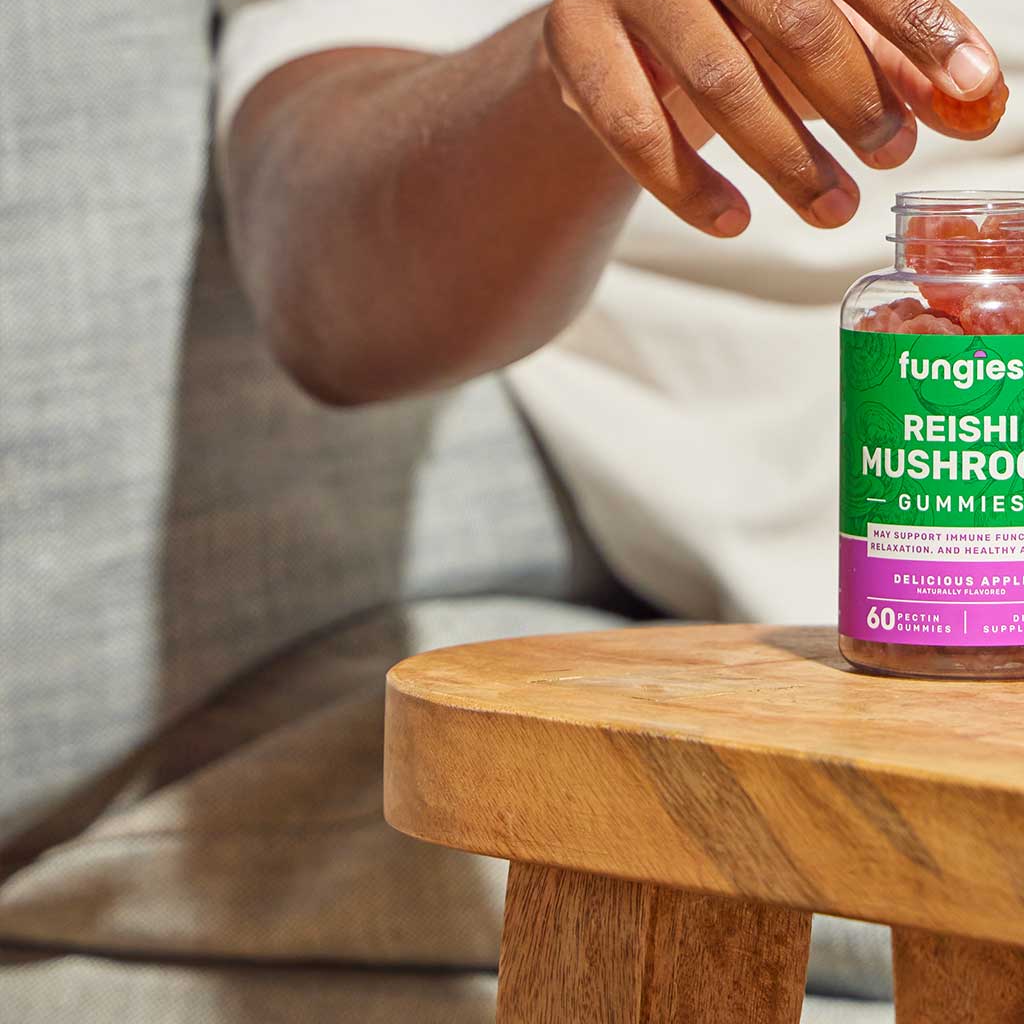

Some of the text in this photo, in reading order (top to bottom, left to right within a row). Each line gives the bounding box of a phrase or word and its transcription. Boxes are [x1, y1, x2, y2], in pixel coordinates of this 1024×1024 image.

[904, 415, 1018, 442] REISHI
[898, 494, 1024, 512] GUMMIES
[874, 530, 892, 538] MAY
[894, 532, 942, 540] SUPPORT
[946, 533, 991, 541] IMMUNE
[938, 546, 960, 554] AND
[965, 546, 1016, 554] HEALTHY
[894, 574, 974, 586] DELICIOUS
[866, 606, 895, 630] 60
[898, 613, 940, 622] PECTIN
[898, 624, 952, 632] GUMMIES
